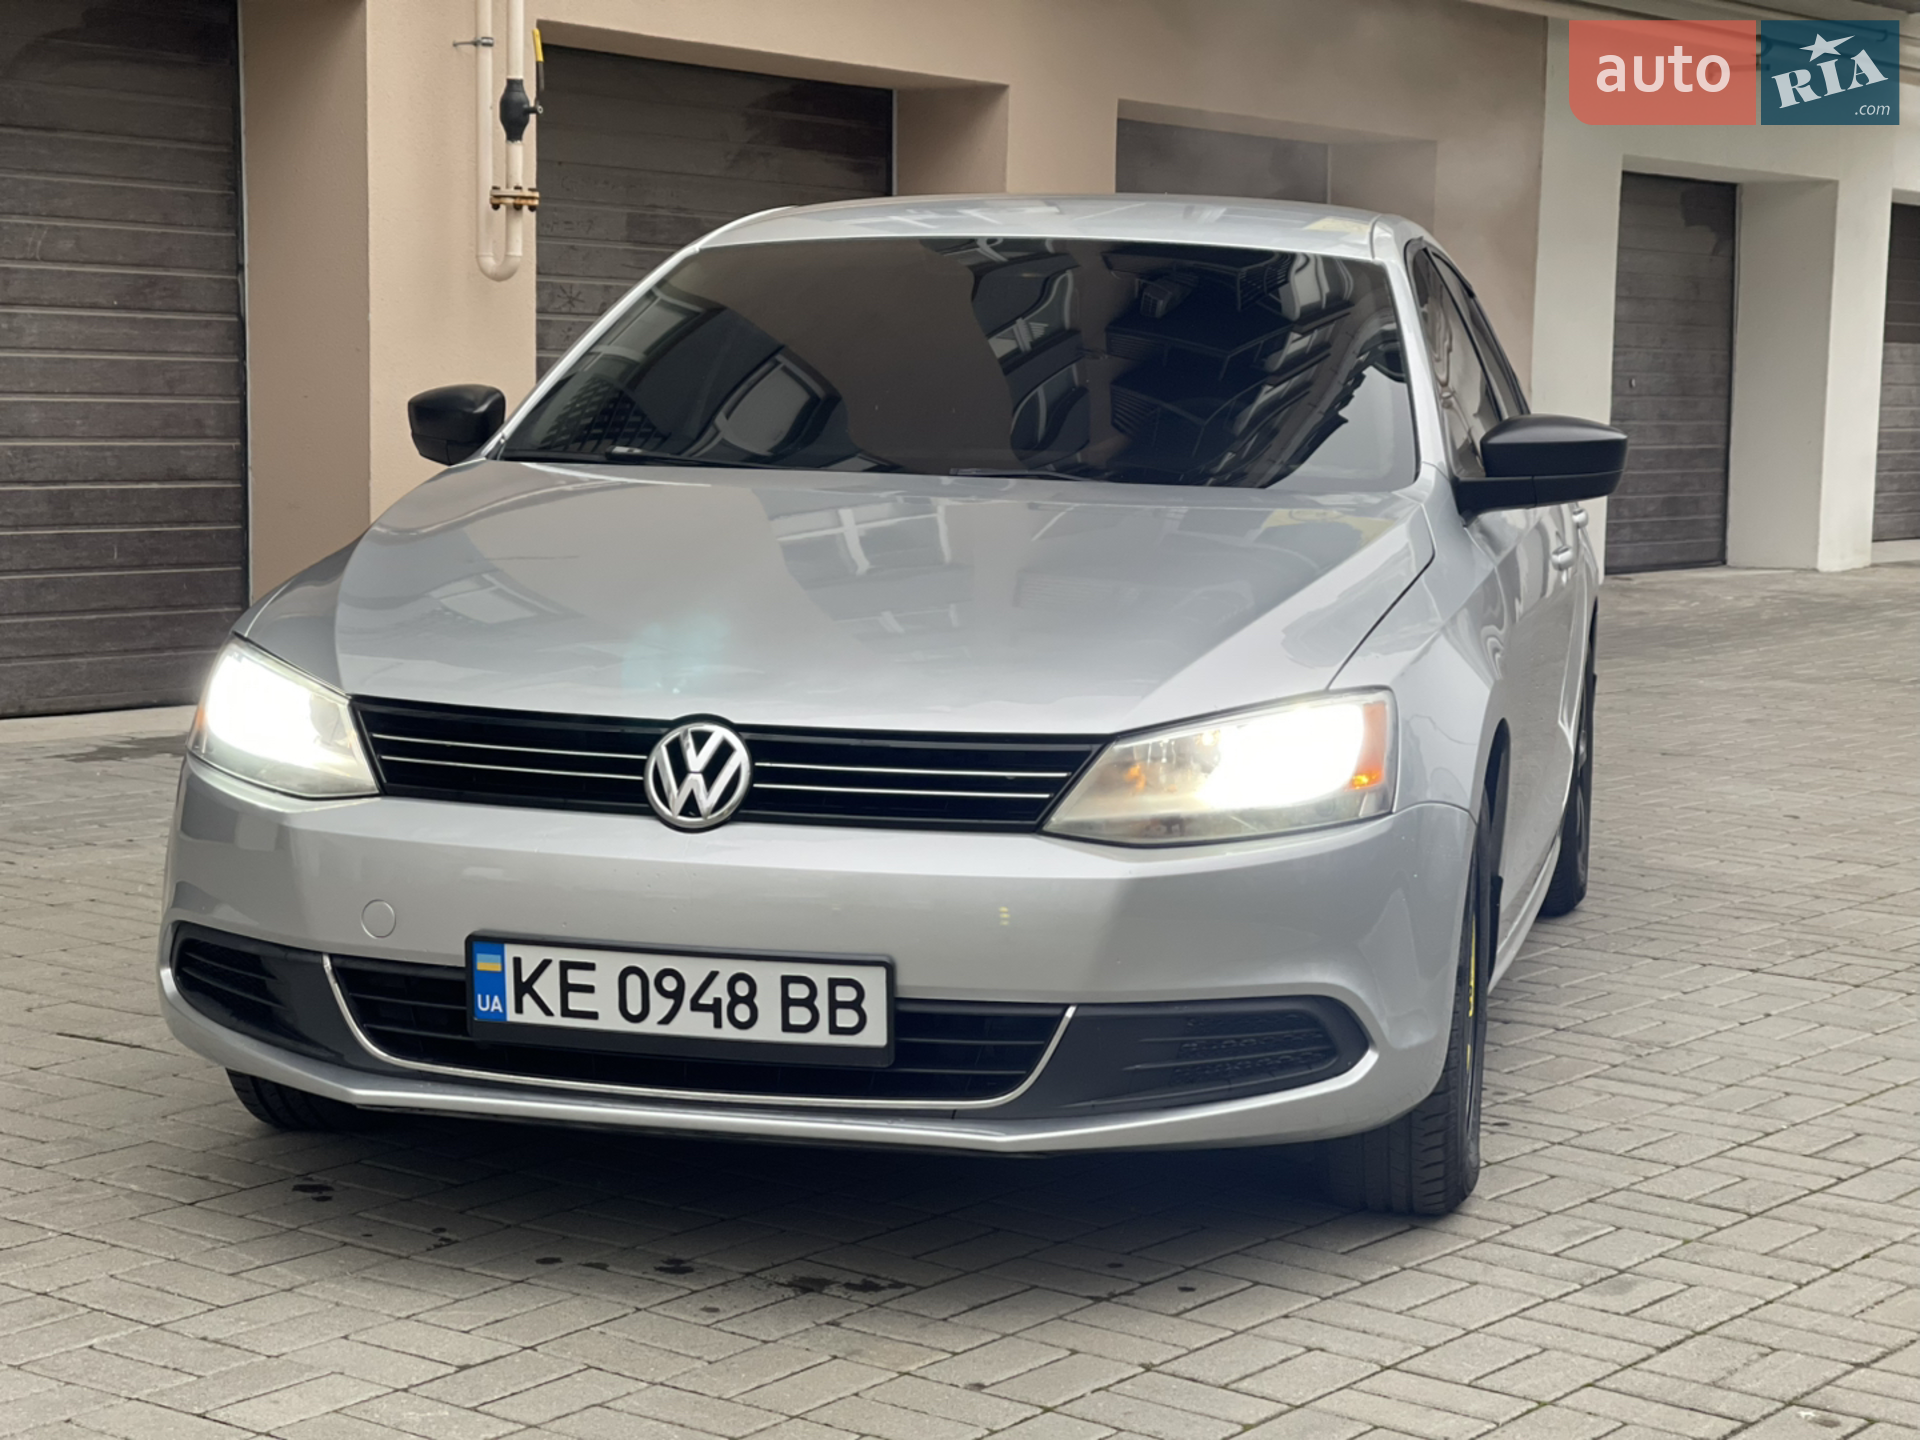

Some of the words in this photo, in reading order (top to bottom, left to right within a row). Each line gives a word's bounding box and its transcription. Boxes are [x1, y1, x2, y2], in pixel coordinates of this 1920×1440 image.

[654, 726, 745, 821] VW
[477, 993, 503, 1013] UA
[512, 956, 599, 1020] KE
[617, 965, 759, 1031] 0948
[780, 974, 868, 1036] BB
